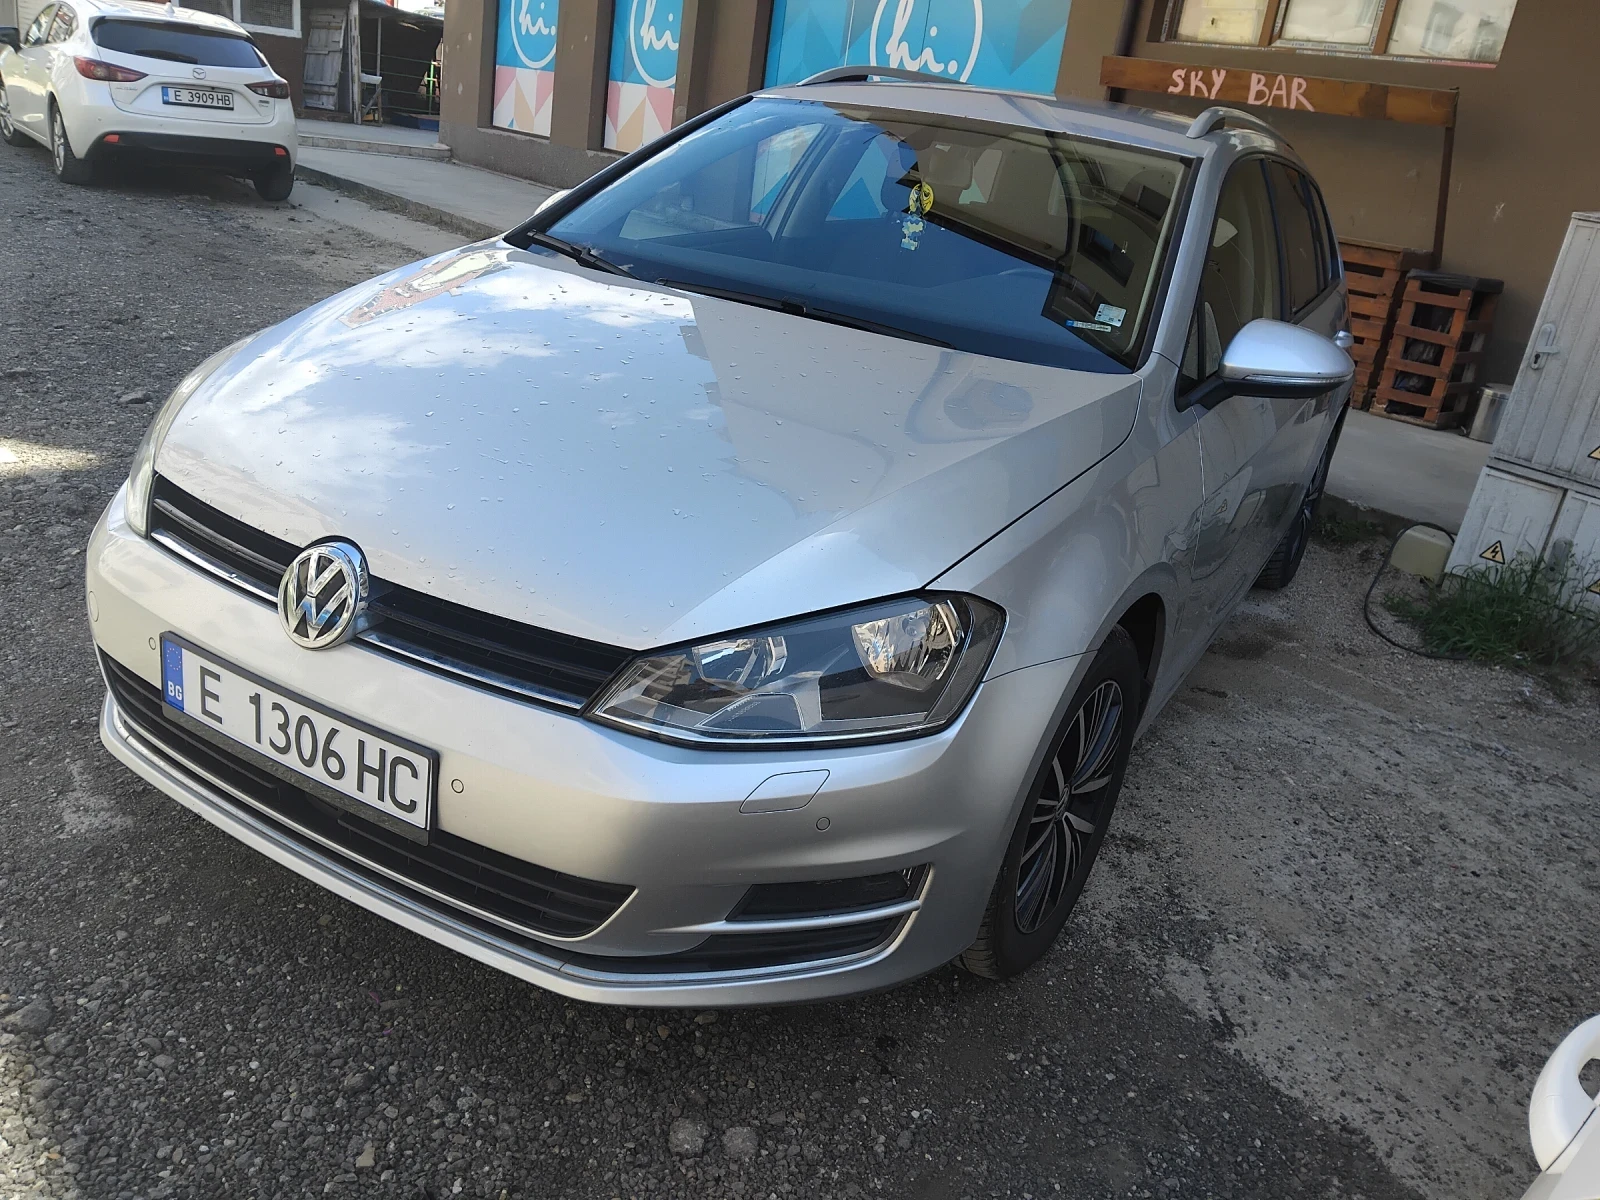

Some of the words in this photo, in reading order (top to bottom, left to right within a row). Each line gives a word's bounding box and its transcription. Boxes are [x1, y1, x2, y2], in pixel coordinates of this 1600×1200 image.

[174, 90, 183, 102] E
[187, 91, 215, 104] 3909
[216, 94, 231, 106] HB
[1167, 68, 1226, 100] SKY
[1247, 72, 1315, 112] BAR
[167, 680, 183, 701] BG
[199, 664, 223, 725] E
[248, 691, 346, 781] 1306
[356, 737, 419, 814] HC
